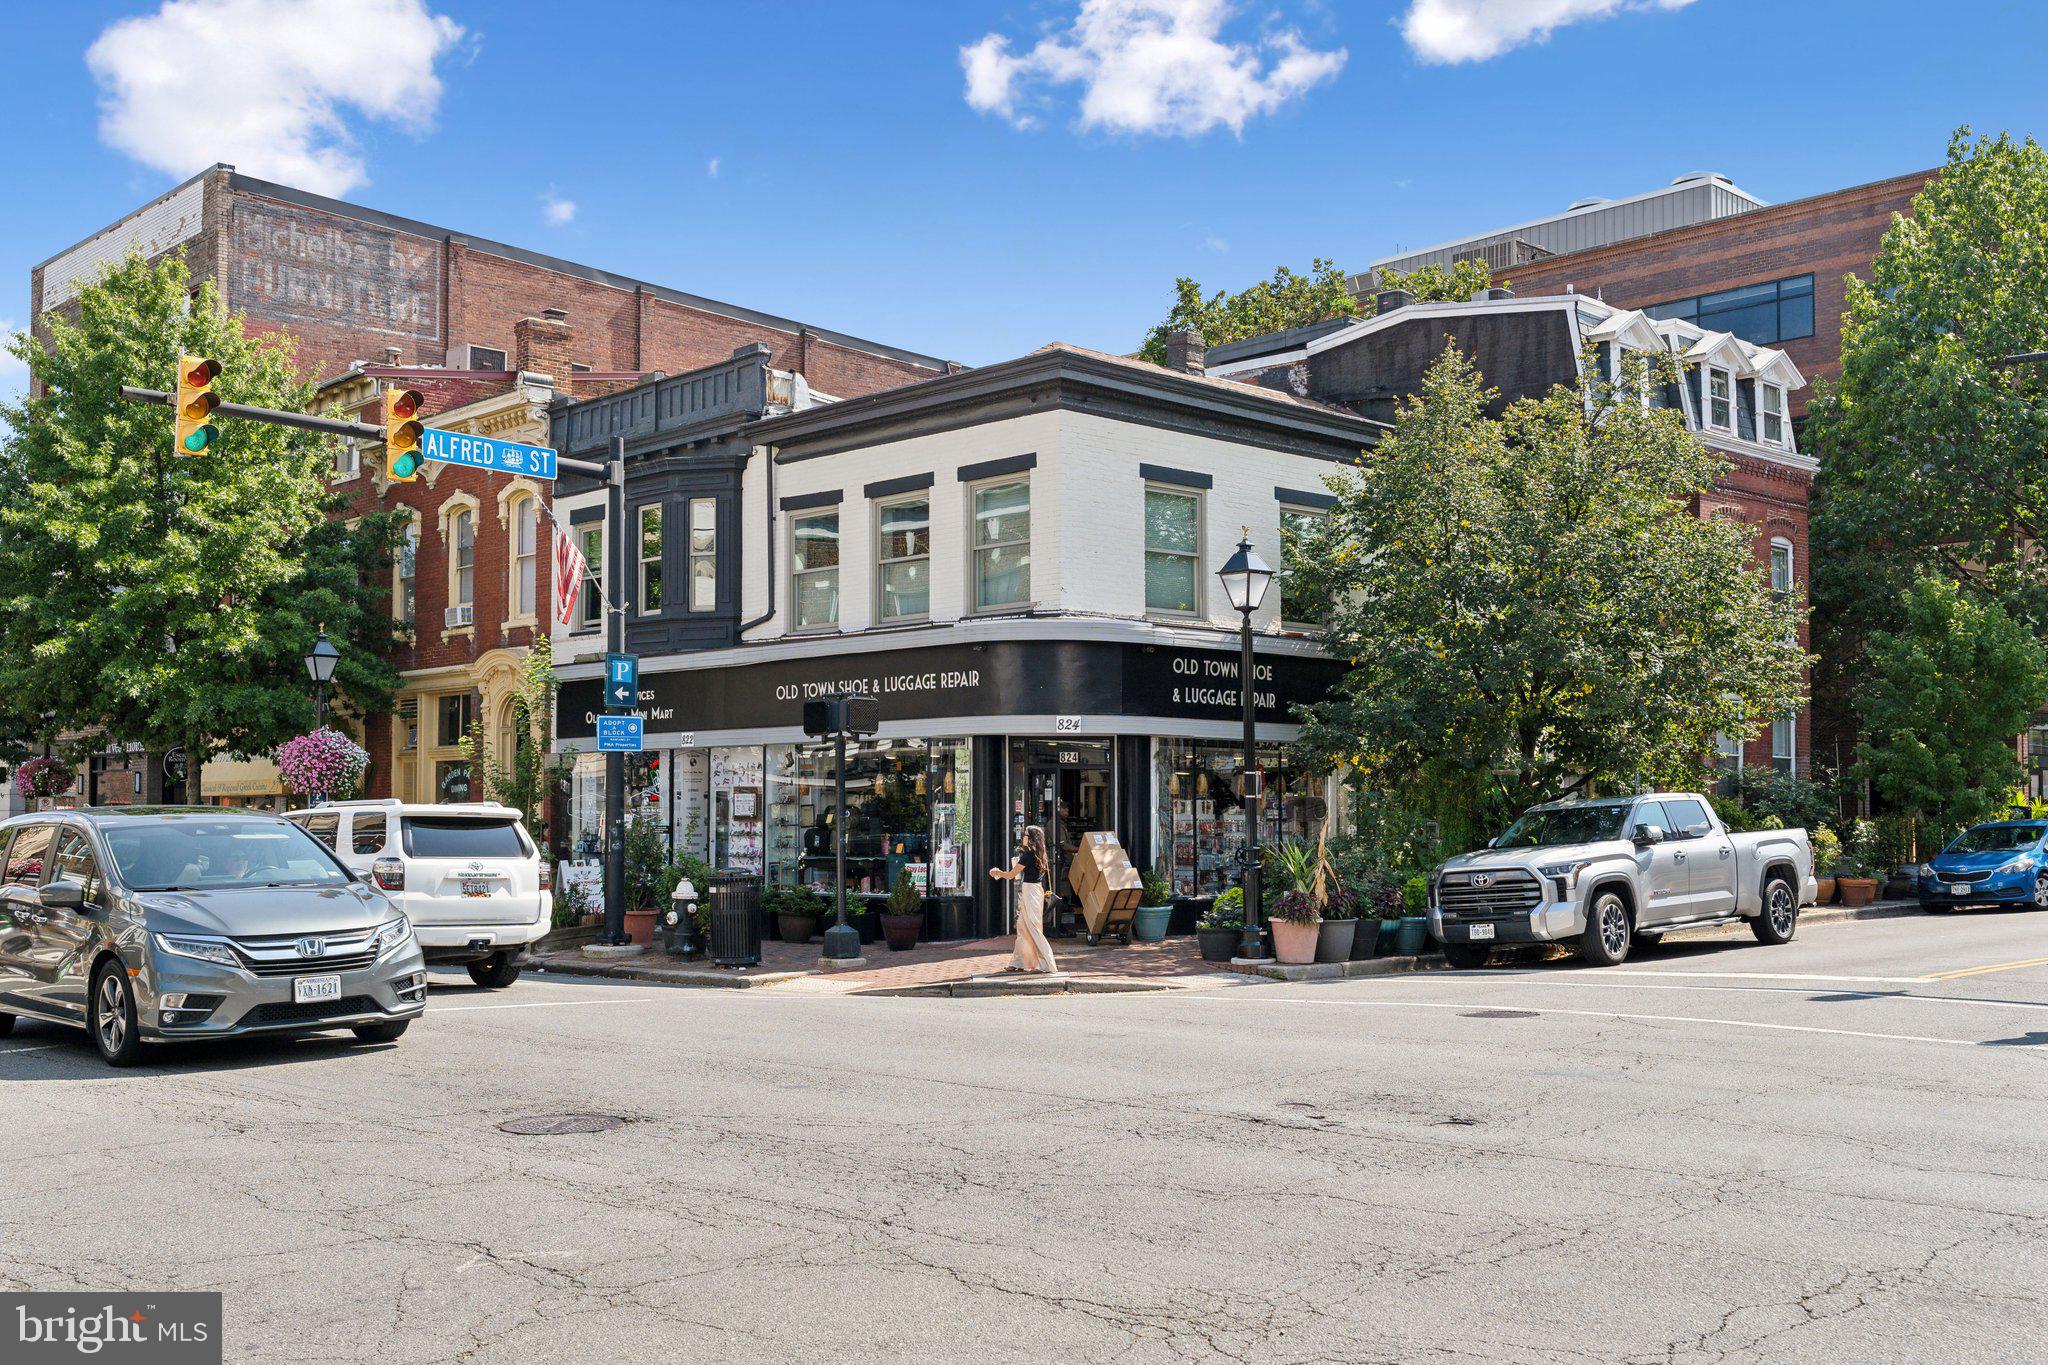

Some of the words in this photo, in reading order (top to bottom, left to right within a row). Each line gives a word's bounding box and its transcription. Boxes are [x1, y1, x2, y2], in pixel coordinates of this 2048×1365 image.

[426, 433, 494, 465] ALFRED
[529, 450, 550, 474] ST
[615, 662, 629, 680] P
[1172, 658, 1199, 675] OLD
[1203, 660, 1238, 678] TOWN
[776, 684, 798, 700] OLD
[802, 681, 835, 698] TOWN
[838, 678, 869, 694] SHOE
[872, 679, 880, 693] &
[884, 673, 936, 693] LUGGAGE
[940, 670, 980, 688] REPAIR
[1172, 687, 1180, 703] &
[1185, 687, 1237, 706] LUGGAGE
[1057, 719, 1080, 730] 824
[681, 734, 694, 745] 822
[1060, 752, 1077, 762] 824
